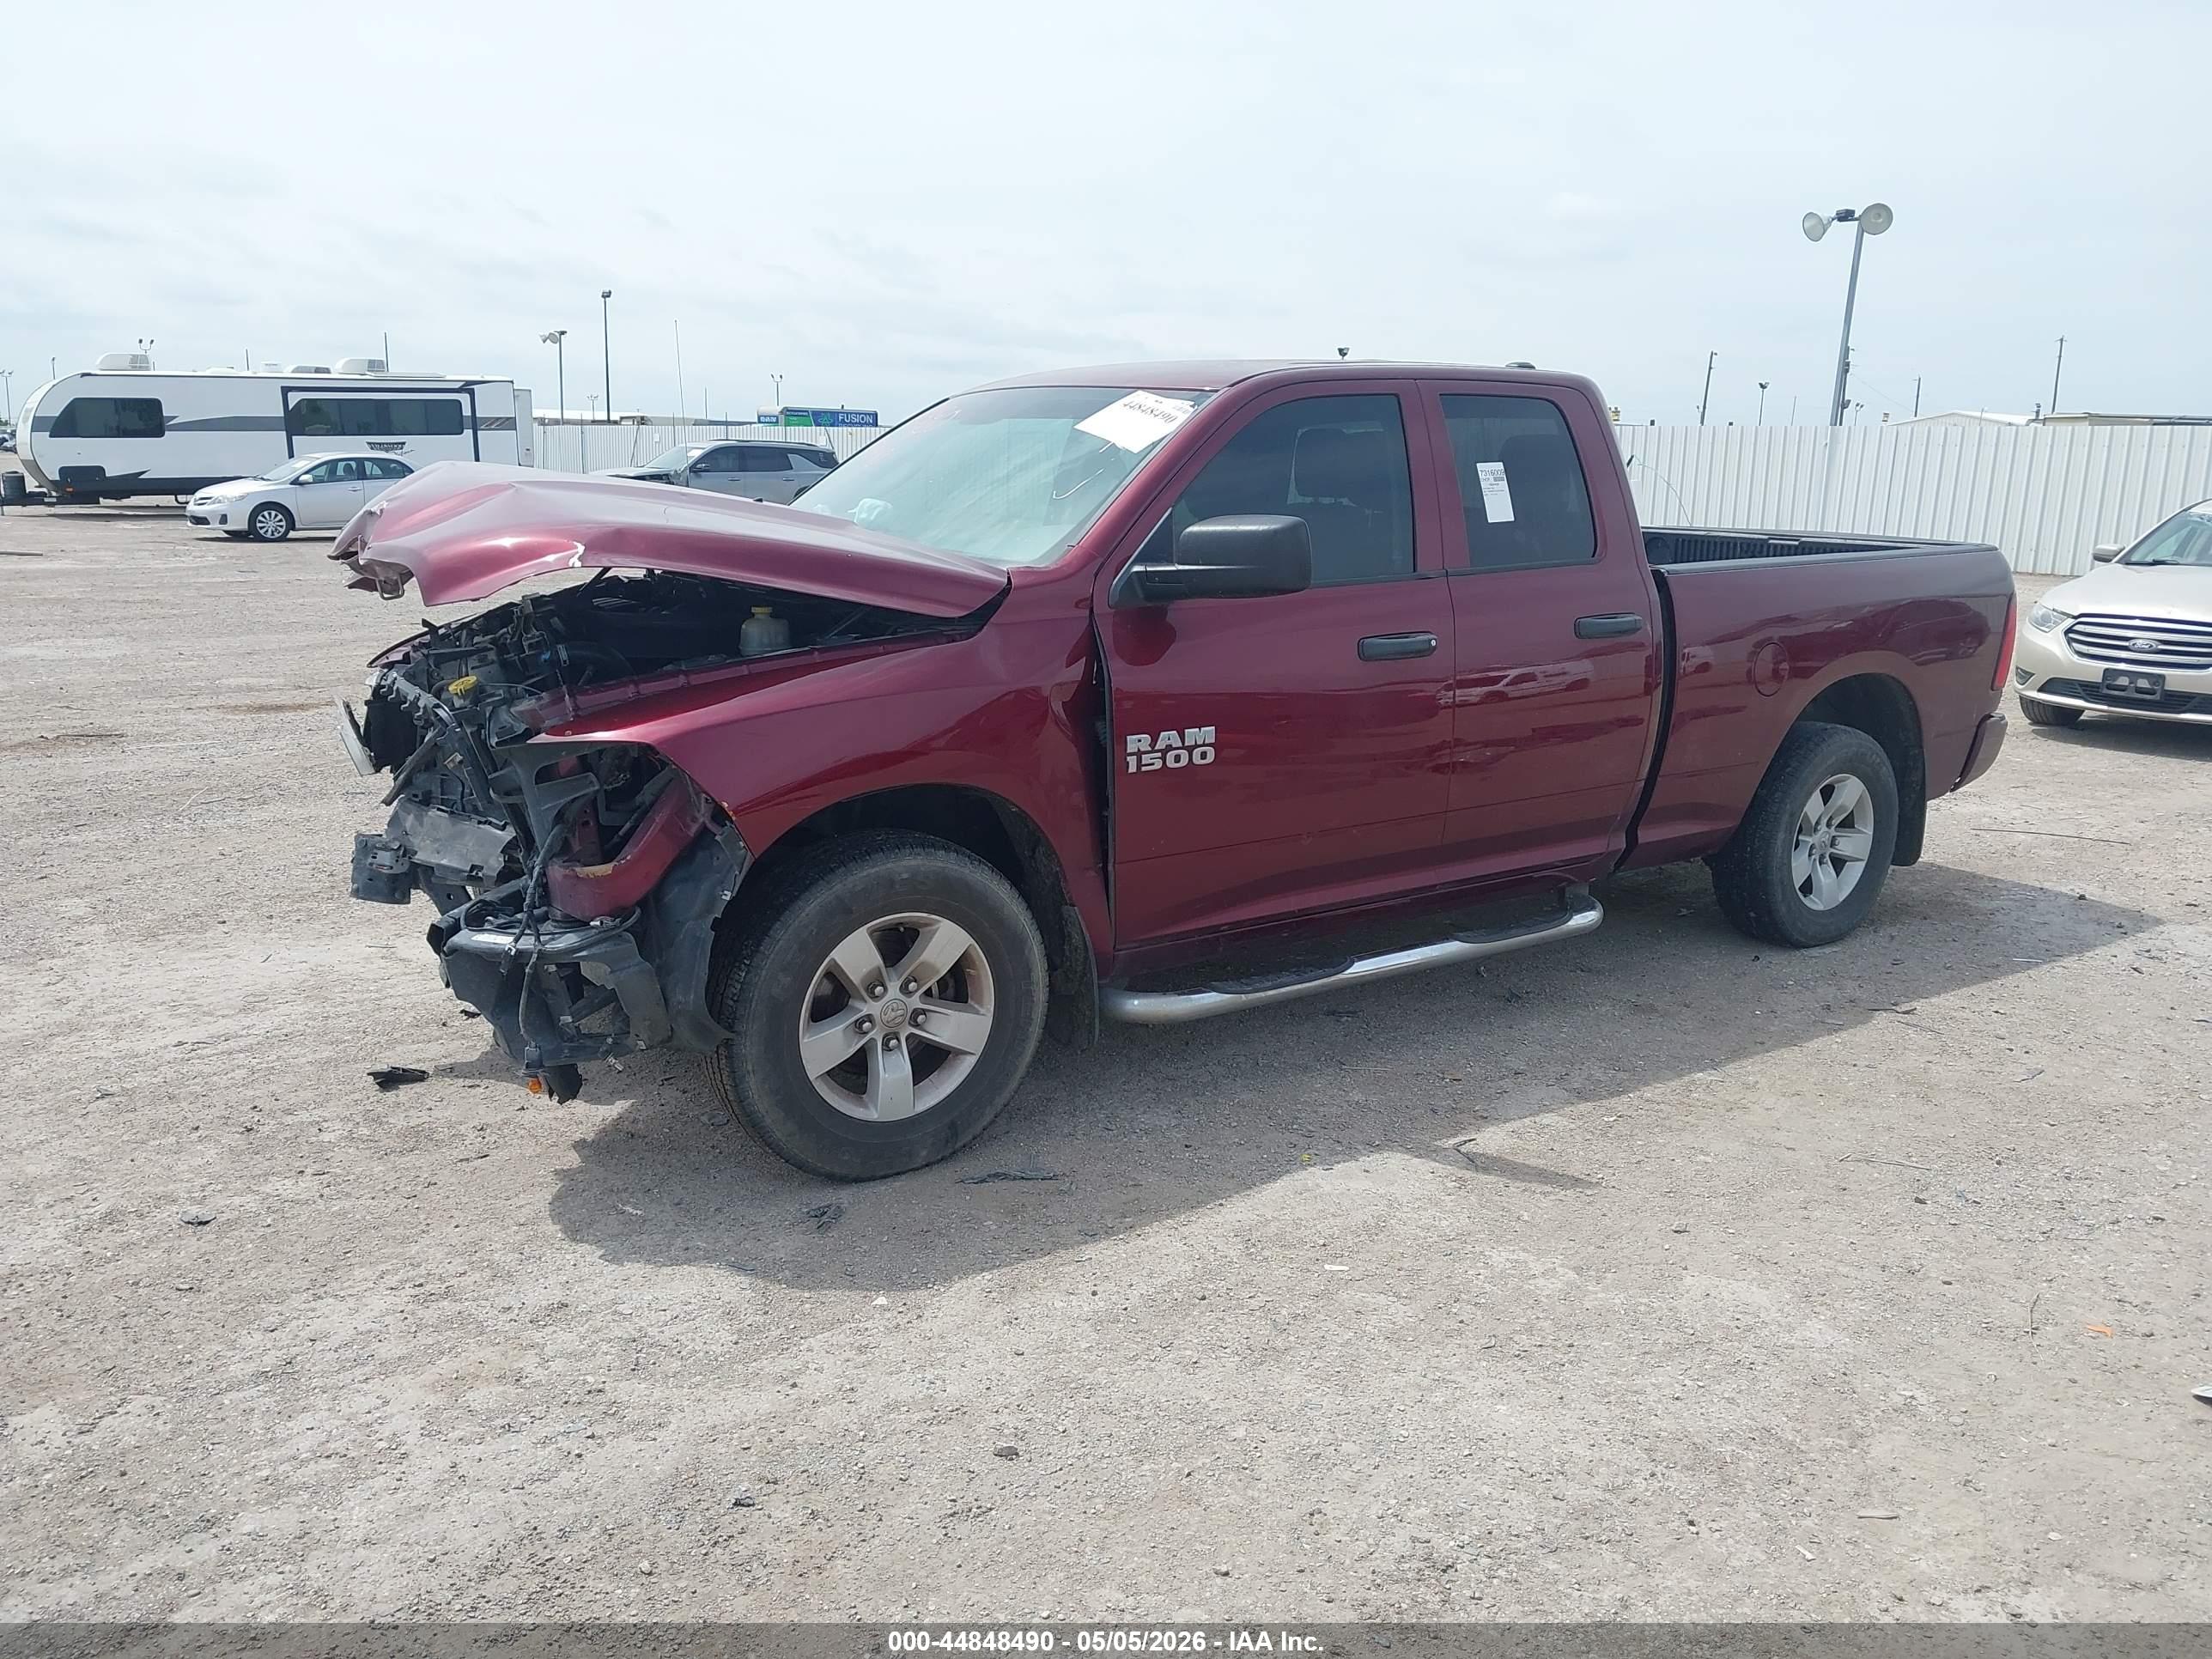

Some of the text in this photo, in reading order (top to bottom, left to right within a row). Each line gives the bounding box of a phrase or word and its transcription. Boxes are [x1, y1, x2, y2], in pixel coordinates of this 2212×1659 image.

[838, 413, 873, 423] FUSION
[1126, 726, 1216, 753] RAM
[1126, 746, 1215, 774] 1500
